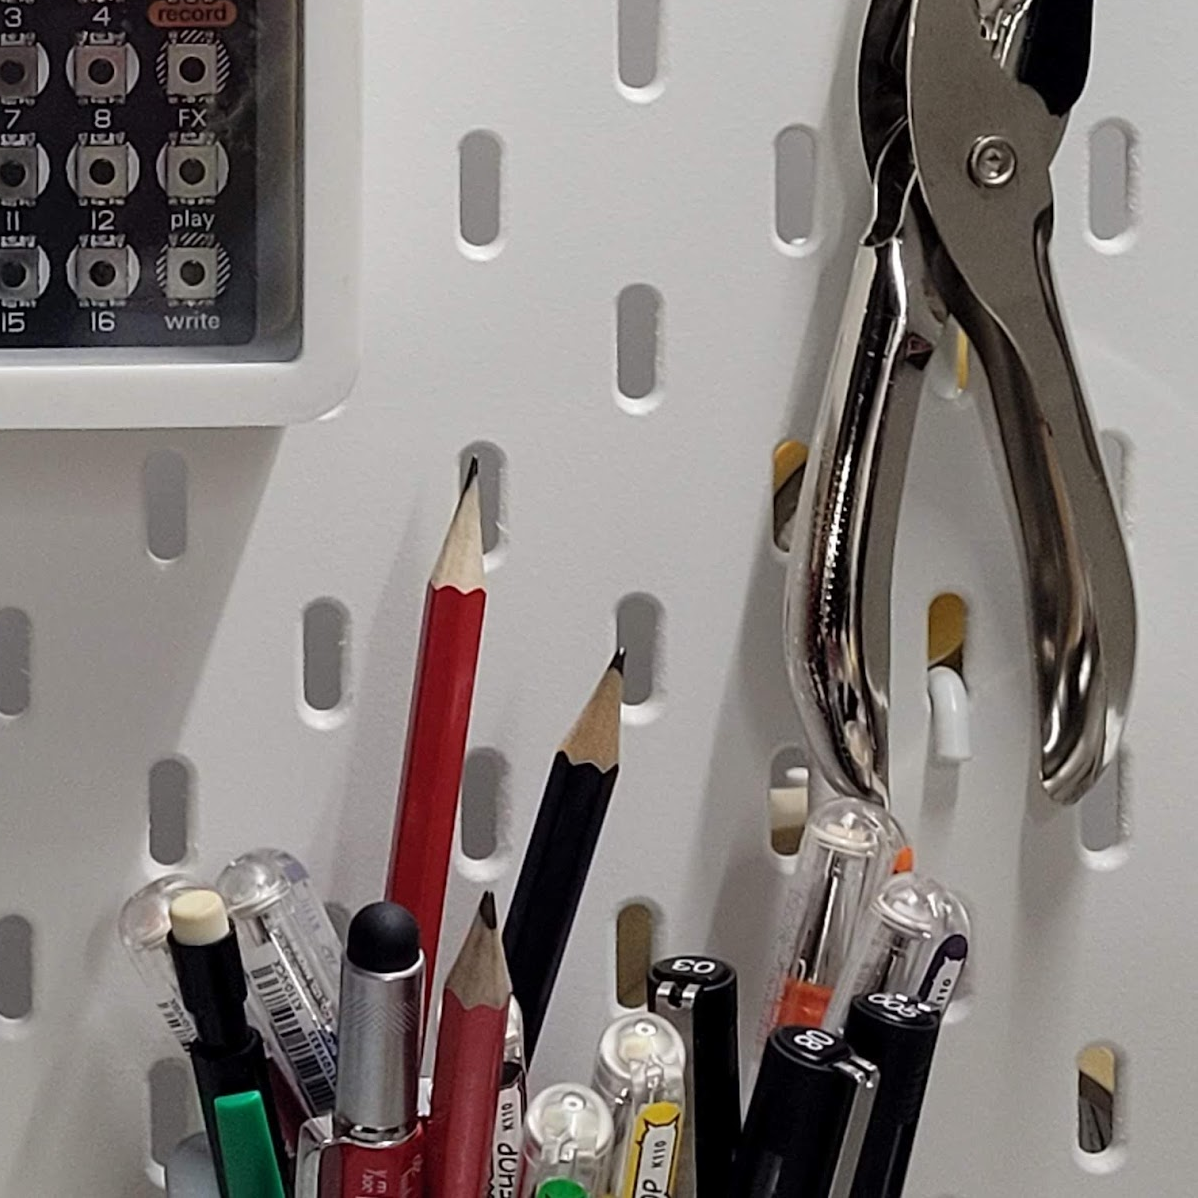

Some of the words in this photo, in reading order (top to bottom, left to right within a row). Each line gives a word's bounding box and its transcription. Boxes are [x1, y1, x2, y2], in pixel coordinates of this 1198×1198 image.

[5, 7, 21, 27] 3
[93, 7, 110, 26] 4
[158, 5, 226, 22] record
[5, 110, 20, 129] 7
[95, 109, 110, 128] 8
[179, 109, 207, 127] FX
[6, 211, 21, 231] 11
[92, 210, 114, 230] 12
[171, 210, 215, 232] play
[2, 312, 25, 332] 15
[92, 311, 115, 331] 16
[165, 312, 219, 329] write
[672, 958, 716, 974] 03
